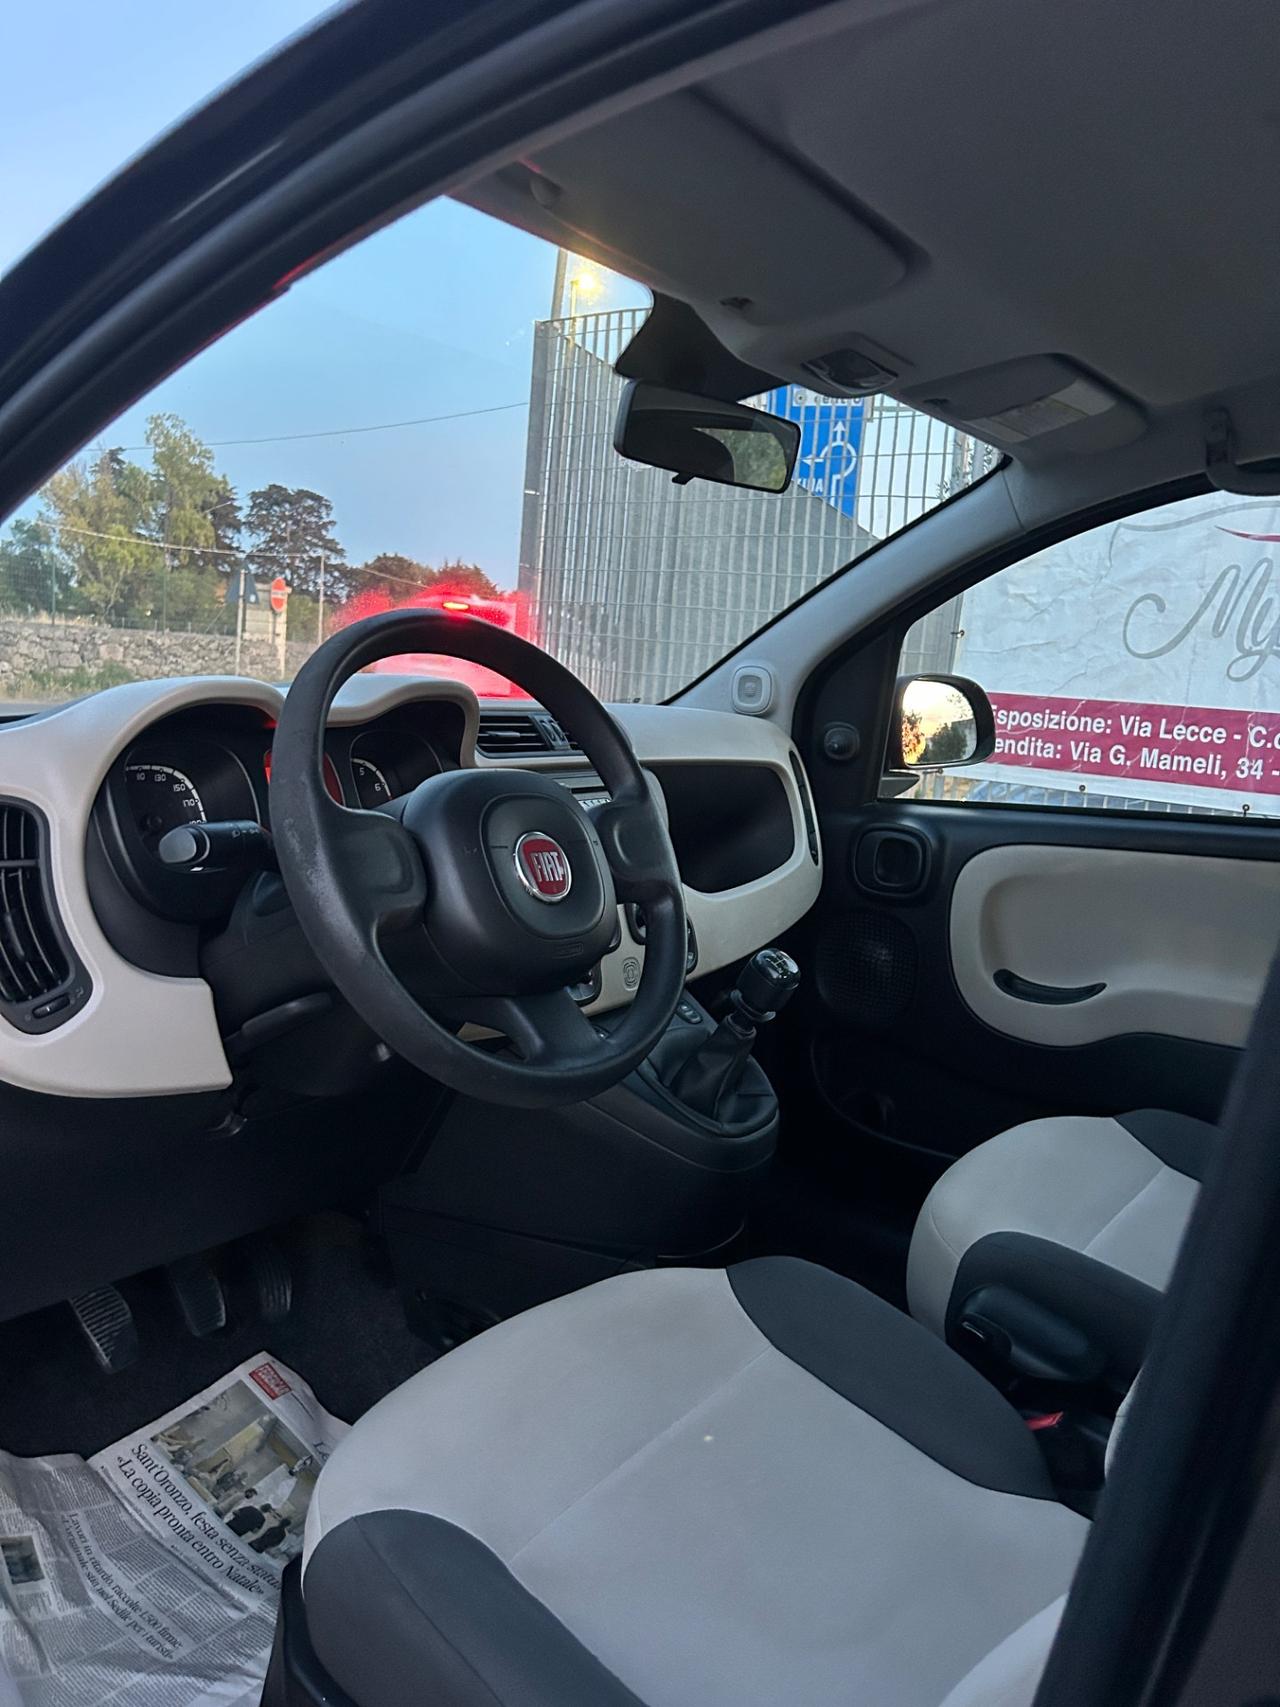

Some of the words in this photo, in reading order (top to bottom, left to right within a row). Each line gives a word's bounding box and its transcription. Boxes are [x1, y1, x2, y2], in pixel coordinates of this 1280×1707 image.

[1122, 557, 1280, 682] My
[1120, 715, 1152, 738] Via
[1159, 718, 1227, 744] Lecce
[359, 767, 365, 776] 5
[994, 736, 1062, 759] endita:
[1070, 740, 1102, 763] Via
[1109, 744, 1131, 766] G.
[1140, 747, 1227, 780] Mameli,
[1235, 757, 1263, 780] 34
[173, 783, 186, 792] 150
[374, 782, 381, 792] 6
[183, 798, 196, 807] 170
[530, 851, 564, 882] FIAT
[131, 1477, 163, 1509] copia
[153, 1505, 195, 1542] pronta
[191, 1540, 225, 1570] entro
[191, 1511, 219, 1540] festa
[216, 1538, 250, 1567] senza
